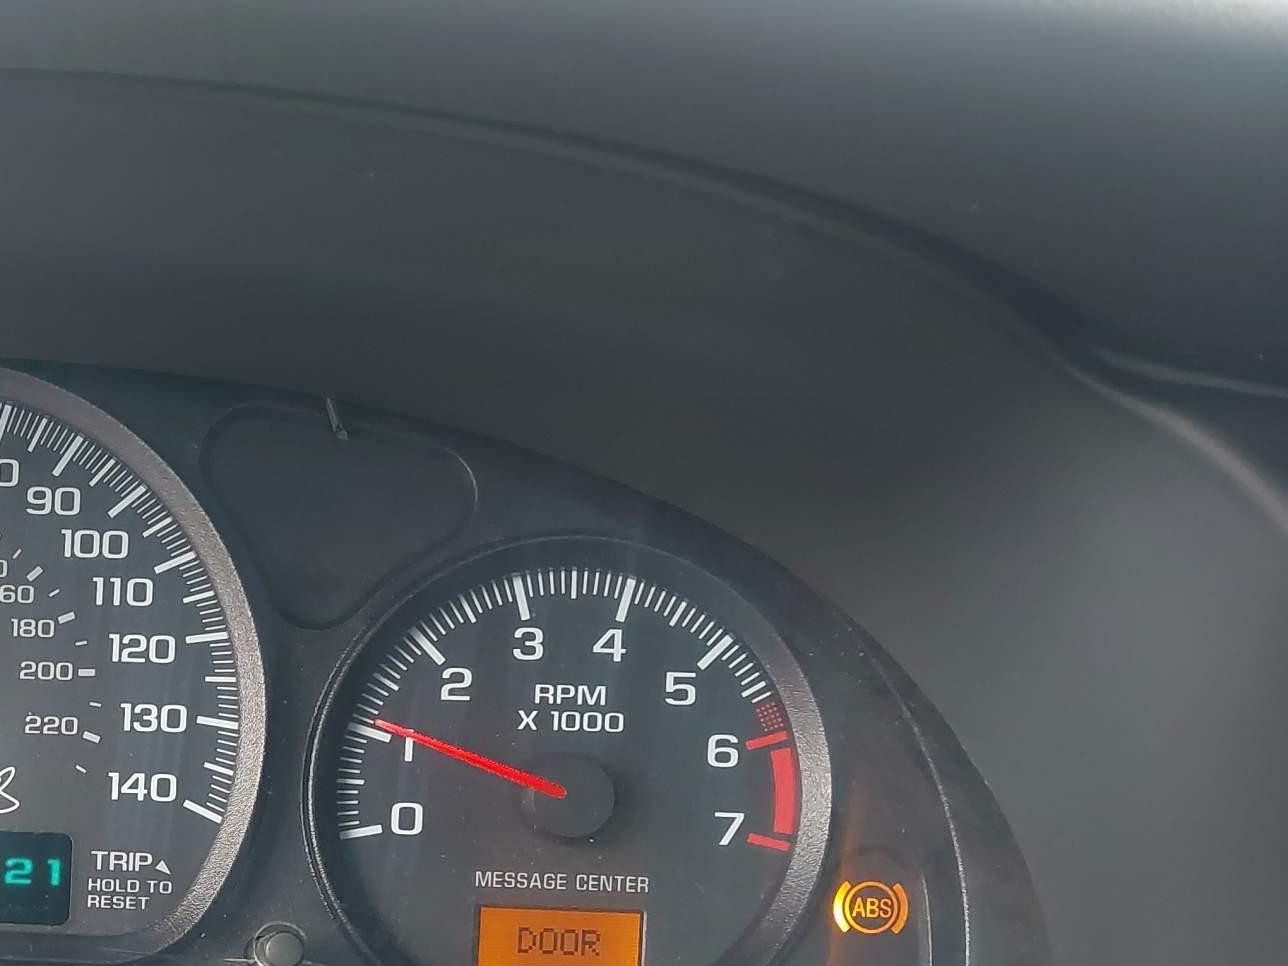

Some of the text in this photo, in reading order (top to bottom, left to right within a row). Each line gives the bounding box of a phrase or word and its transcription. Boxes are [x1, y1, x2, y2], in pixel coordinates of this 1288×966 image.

[25, 487, 81, 515] 90
[60, 529, 129, 558] 100
[92, 577, 154, 607] 110
[11, 618, 55, 638] 180
[108, 634, 176, 664] 120
[513, 627, 544, 660] 3
[593, 629, 627, 662] 4
[19, 662, 73, 681] 200
[440, 667, 473, 701] 2
[534, 683, 607, 706] RPM
[664, 672, 696, 705] 5
[24, 715, 78, 735] 220
[120, 703, 187, 733] 130
[517, 710, 624, 734] X 1000
[707, 734, 739, 768] 6
[108, 772, 177, 801] 140
[390, 802, 423, 836] 0
[714, 812, 745, 846] 7
[91, 850, 153, 872] TRIP
[88, 878, 173, 895] HOLD TO
[475, 871, 649, 893] MESSAGE CENTER
[87, 895, 150, 911] RESET
[852, 897, 892, 919] ABS
[518, 926, 601, 957] DOOR
